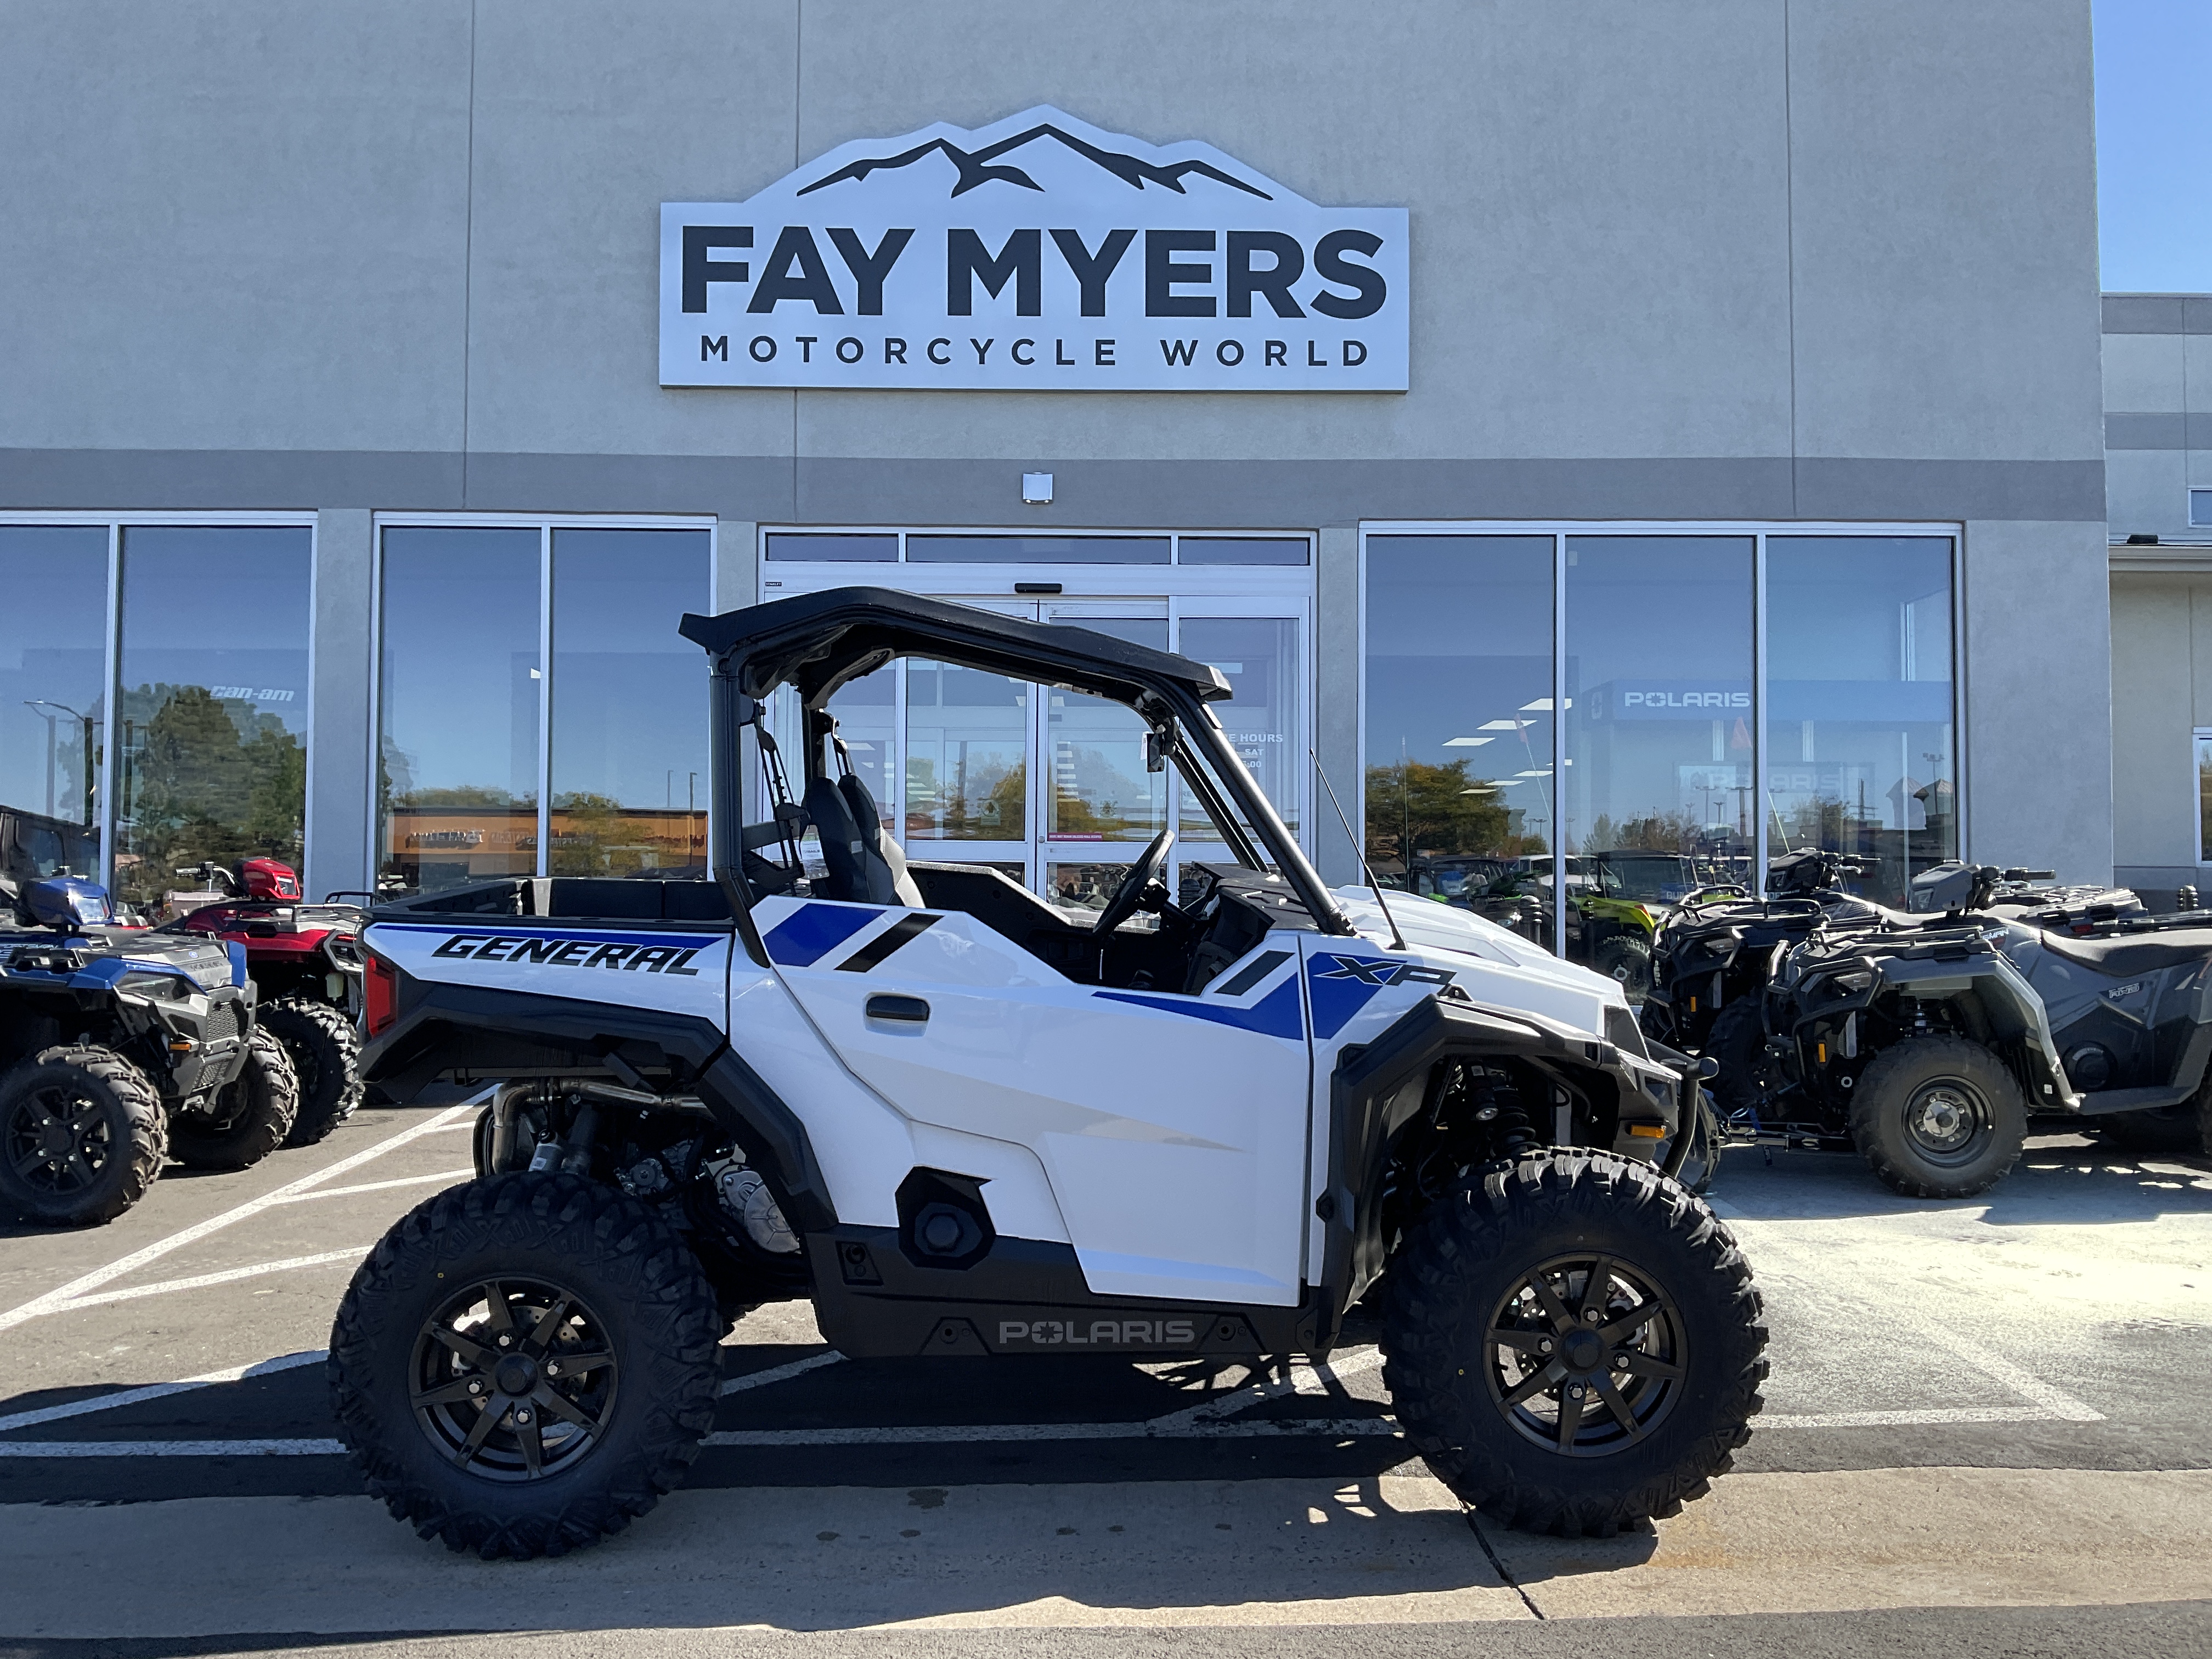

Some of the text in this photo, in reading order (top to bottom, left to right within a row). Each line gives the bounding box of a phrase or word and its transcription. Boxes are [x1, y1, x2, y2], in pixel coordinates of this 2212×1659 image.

[682, 225, 1386, 319] FAY MYERS
[702, 335, 1367, 366] MOTORCYCLE WORLD
[210, 686, 295, 701] can-am
[1625, 692, 1750, 707] POLARIS
[1240, 733, 1283, 742] HOURS
[431, 935, 700, 975] GENERAL
[1313, 955, 1457, 986] XP
[1000, 1321, 1195, 1344] POLARIS
